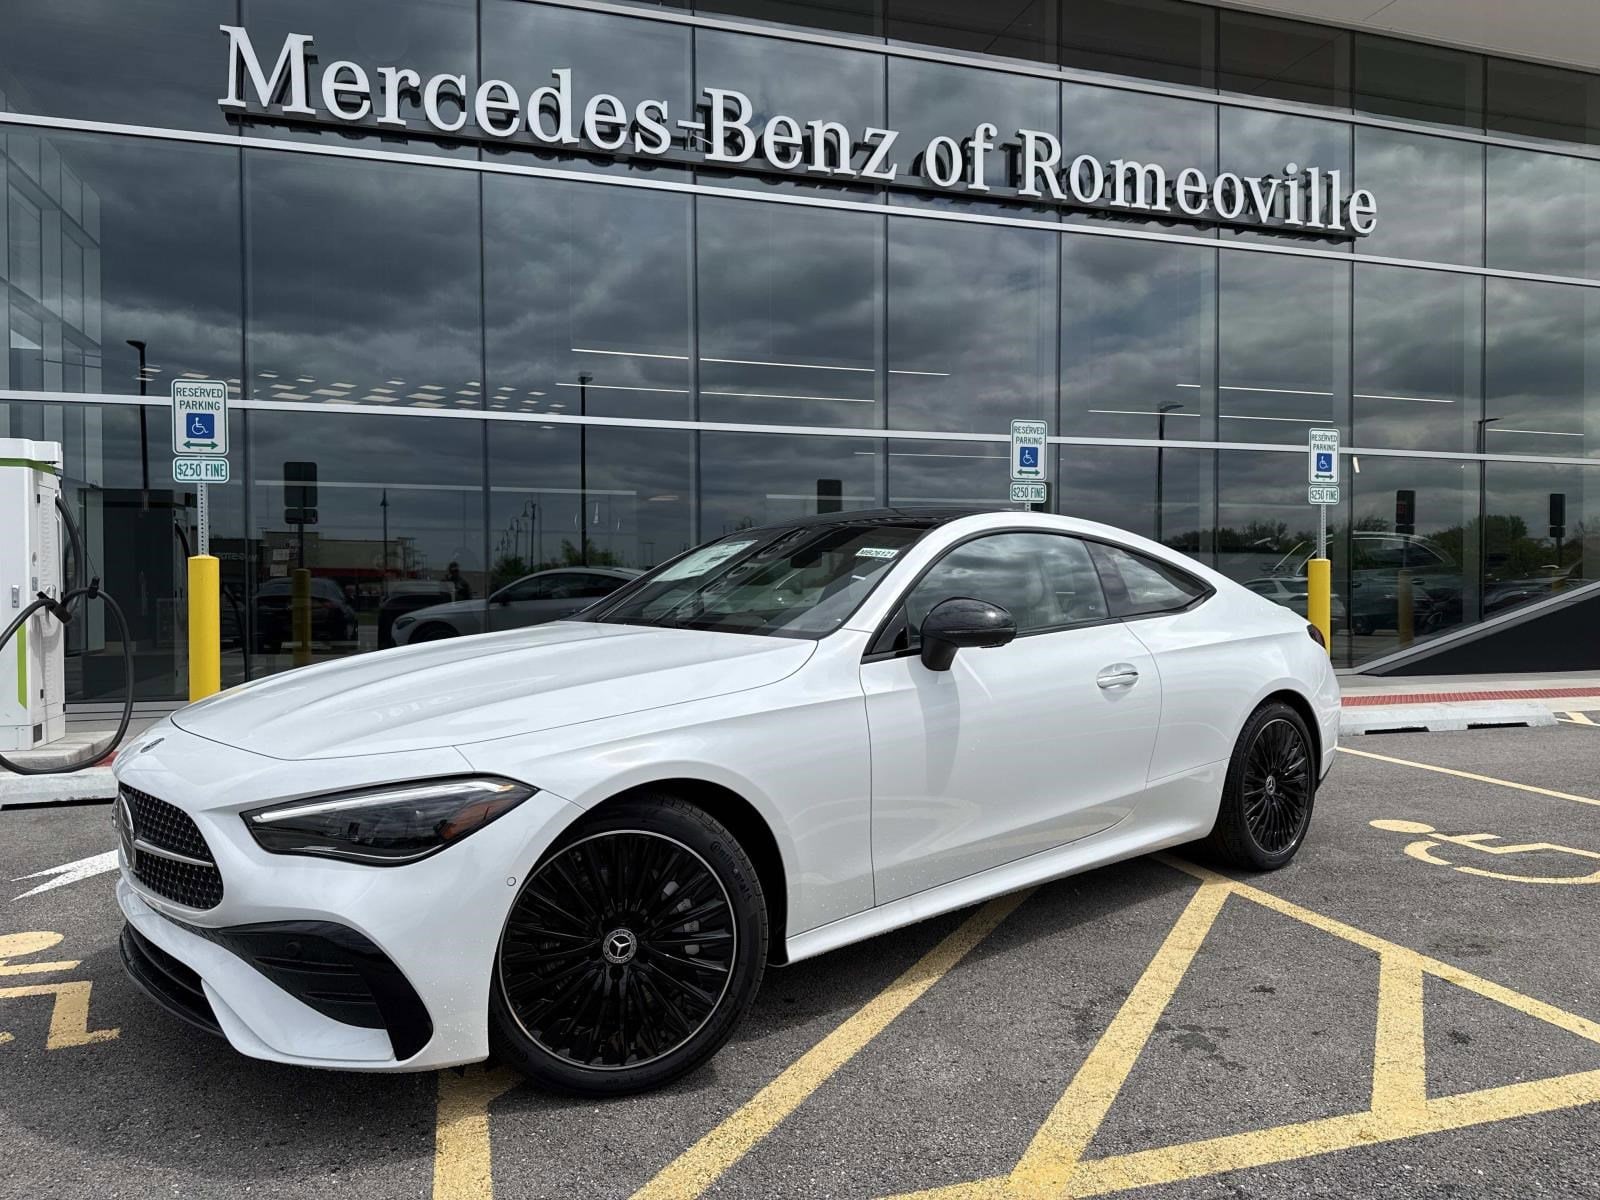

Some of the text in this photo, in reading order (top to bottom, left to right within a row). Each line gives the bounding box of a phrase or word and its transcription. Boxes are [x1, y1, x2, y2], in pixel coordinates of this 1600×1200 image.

[217, 24, 1377, 234] Mercedes-Benz of Romeoville
[176, 387, 223, 398] RESERVED
[179, 400, 220, 411] PARKING
[1013, 426, 1045, 435] RESERVED
[1015, 436, 1043, 445] PARKING
[1311, 433, 1337, 442] RESERVED
[1312, 443, 1336, 452] PARKING
[177, 463, 225, 477] $250 FINE
[1013, 486, 1044, 499] $250 FINE
[1311, 489, 1337, 501] $250 FINE
